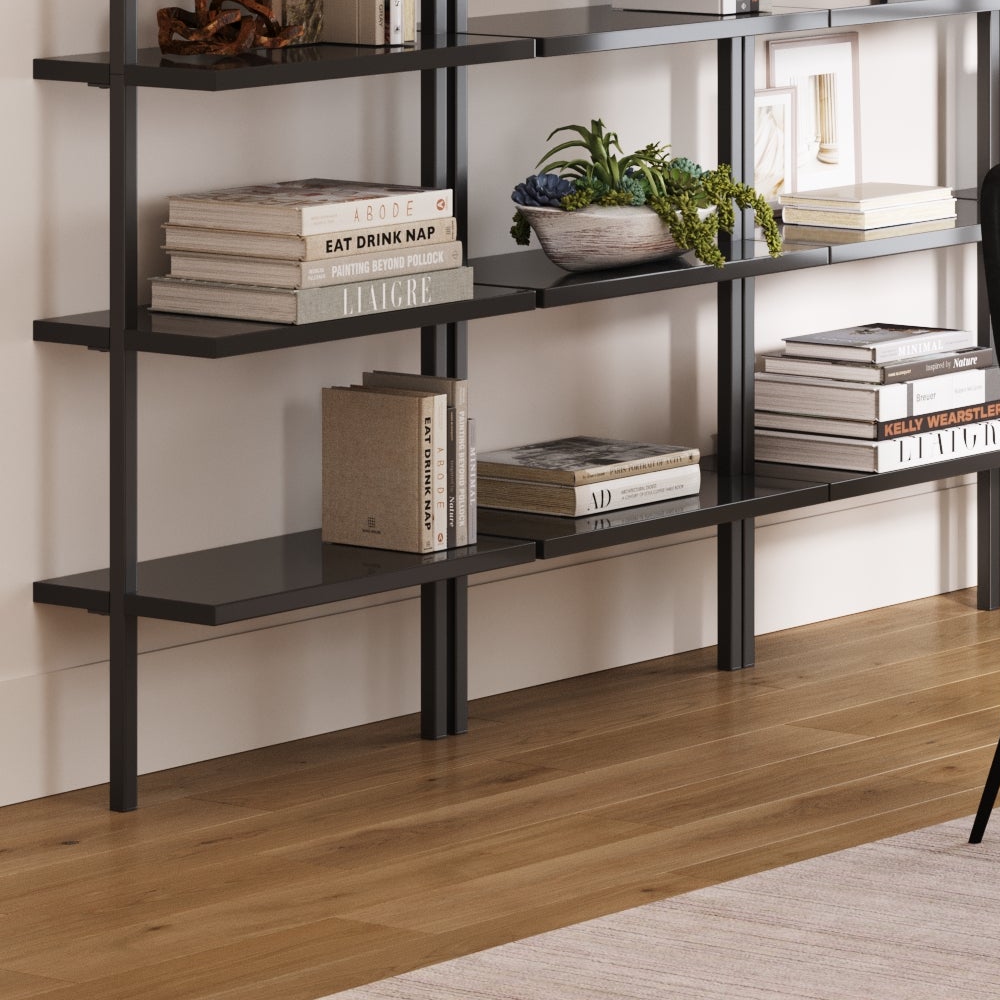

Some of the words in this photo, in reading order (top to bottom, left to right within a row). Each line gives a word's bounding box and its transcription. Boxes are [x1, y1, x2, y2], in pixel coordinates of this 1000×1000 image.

[354, 200, 414, 223] ABODE
[325, 237, 352, 254] EAT
[356, 230, 402, 249] DRINK
[405, 226, 436, 243] NAP
[331, 260, 370, 279] PAINTING
[372, 256, 405, 273] BEYOND
[406, 251, 445, 268] POLLOCK
[343, 276, 432, 316] LIAIGRE
[897, 339, 944, 357] MINIMAL
[953, 356, 978, 369] Nature
[424, 416, 432, 445] EAT
[884, 418, 925, 437] KELLY
[424, 449, 432, 497] DRINK
[436, 447, 445, 510] ABODE
[469, 446, 477, 507] MINIMAL
[424, 499, 432, 531] NAP
[448, 495, 456, 528] Nature
